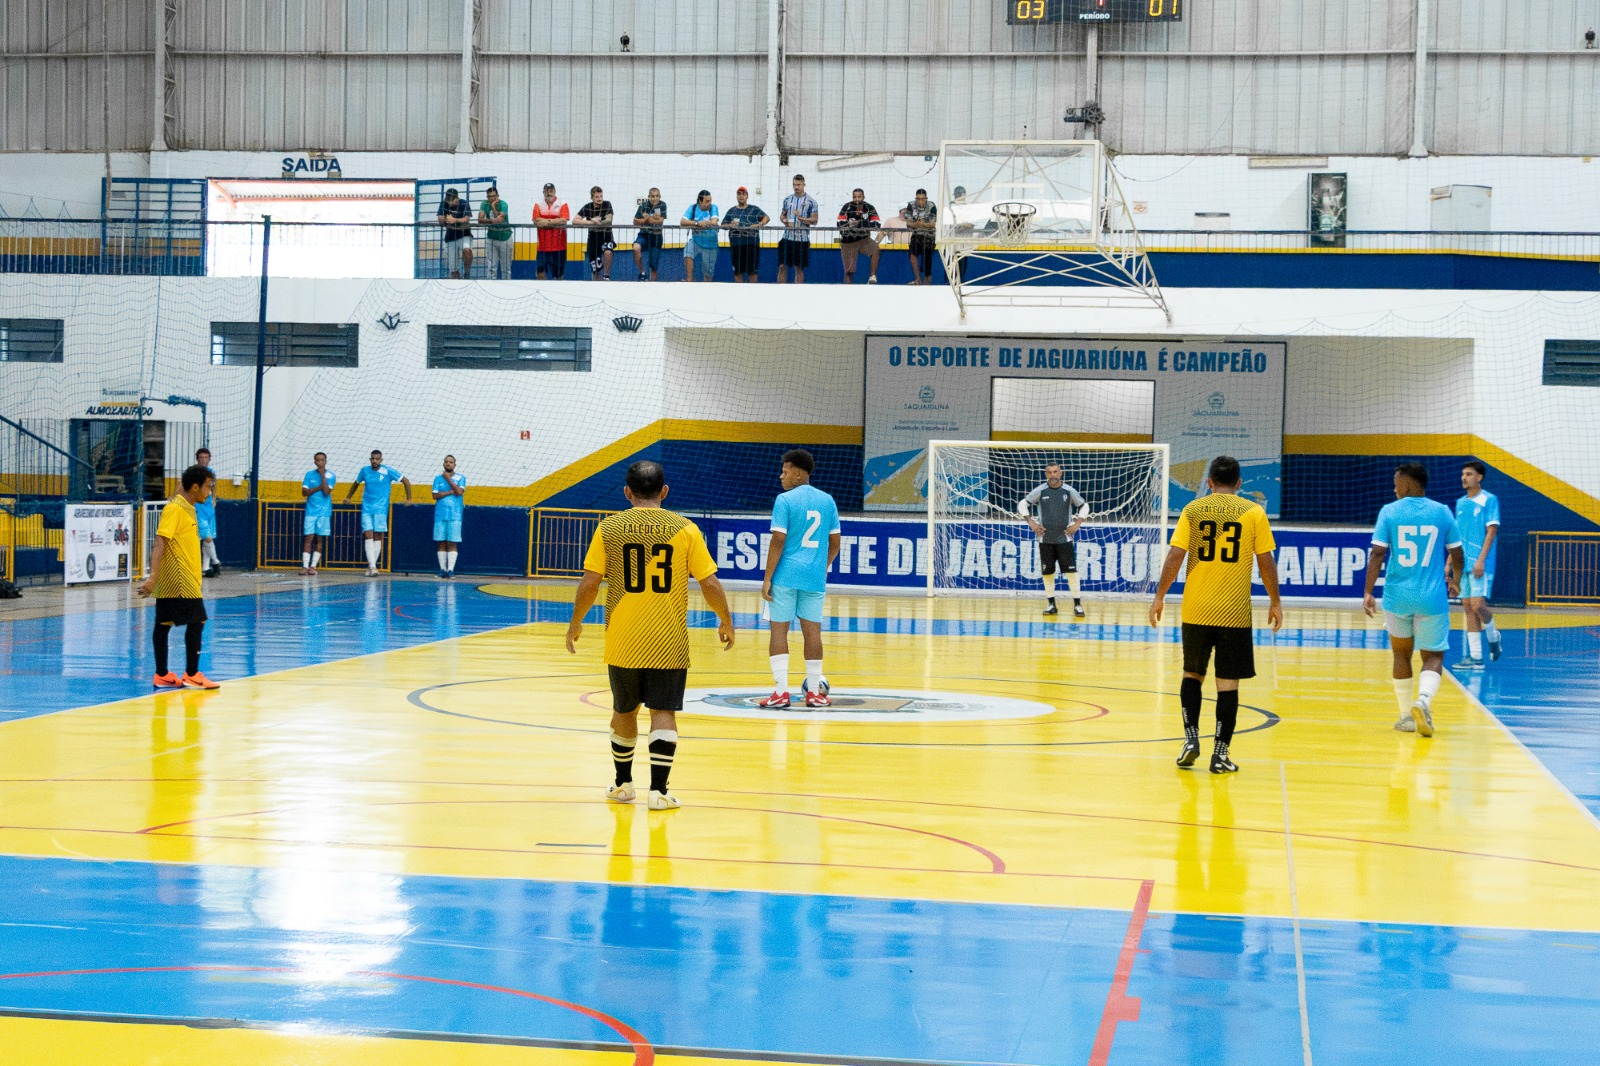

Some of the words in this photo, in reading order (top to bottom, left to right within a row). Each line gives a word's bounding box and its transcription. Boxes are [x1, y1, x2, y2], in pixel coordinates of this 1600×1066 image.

[1017, 1, 1044, 18] 03
[1080, 11, 1110, 20] PERÍODO
[889, 346, 902, 366] O
[907, 346, 989, 367] ESPORTE
[999, 347, 1022, 368] DE
[1027, 346, 1147, 371] JAGUARIÚNA
[1158, 347, 1168, 371] É
[1173, 348, 1267, 373] CAMPEÃO
[801, 510, 821, 548] 2
[1198, 520, 1242, 563] 33
[1398, 525, 1439, 567] 57
[623, 543, 674, 593] 03
